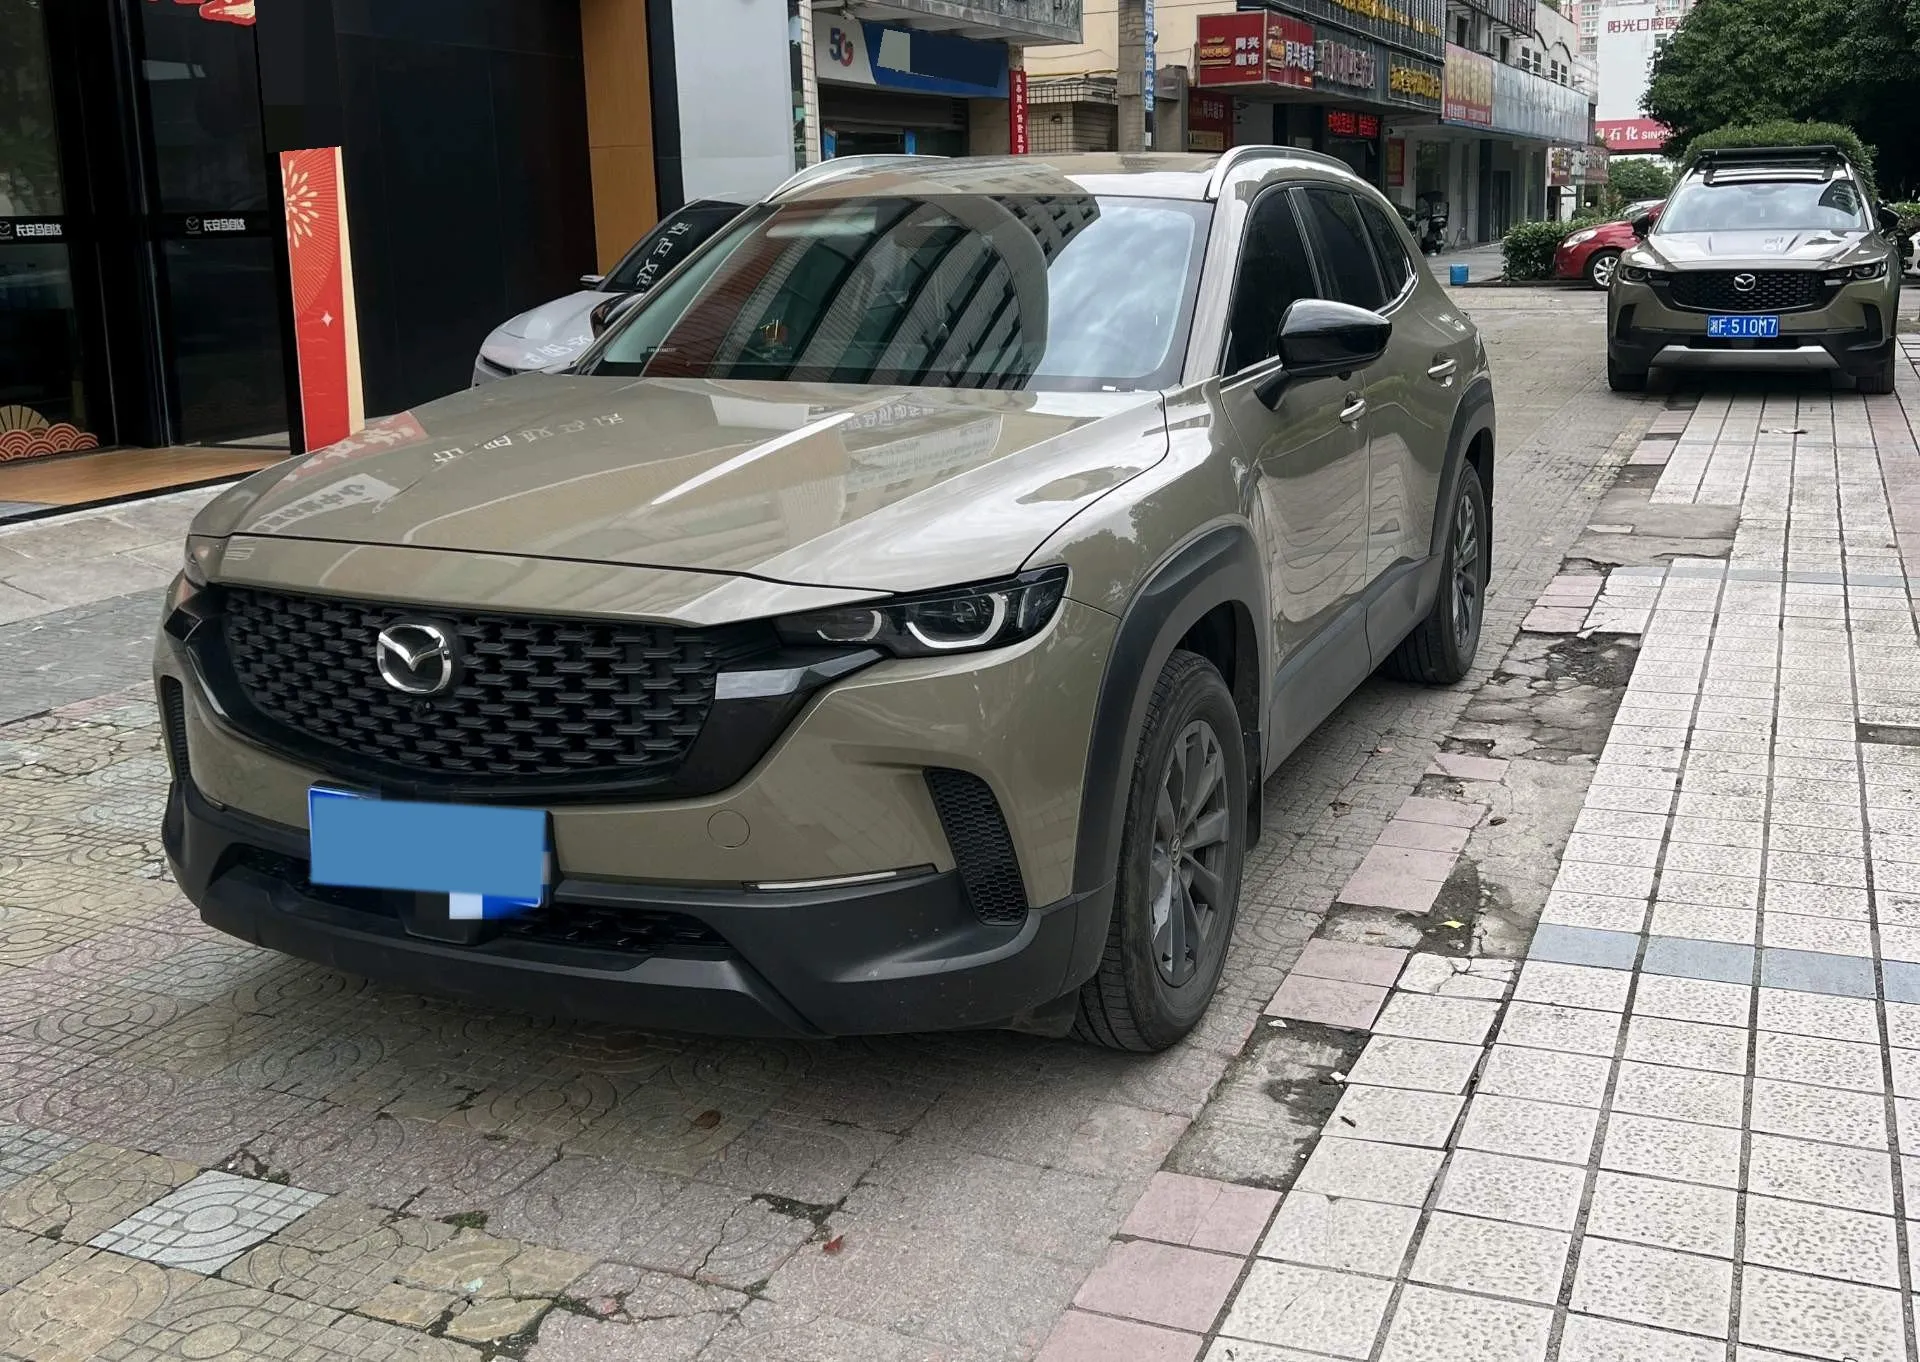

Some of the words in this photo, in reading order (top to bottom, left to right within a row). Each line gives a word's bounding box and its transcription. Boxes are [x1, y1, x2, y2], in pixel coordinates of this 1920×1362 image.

[829, 27, 854, 67] 5G
[16, 223, 63, 237] 长安马自达
[203, 218, 247, 232] 长安马自达
